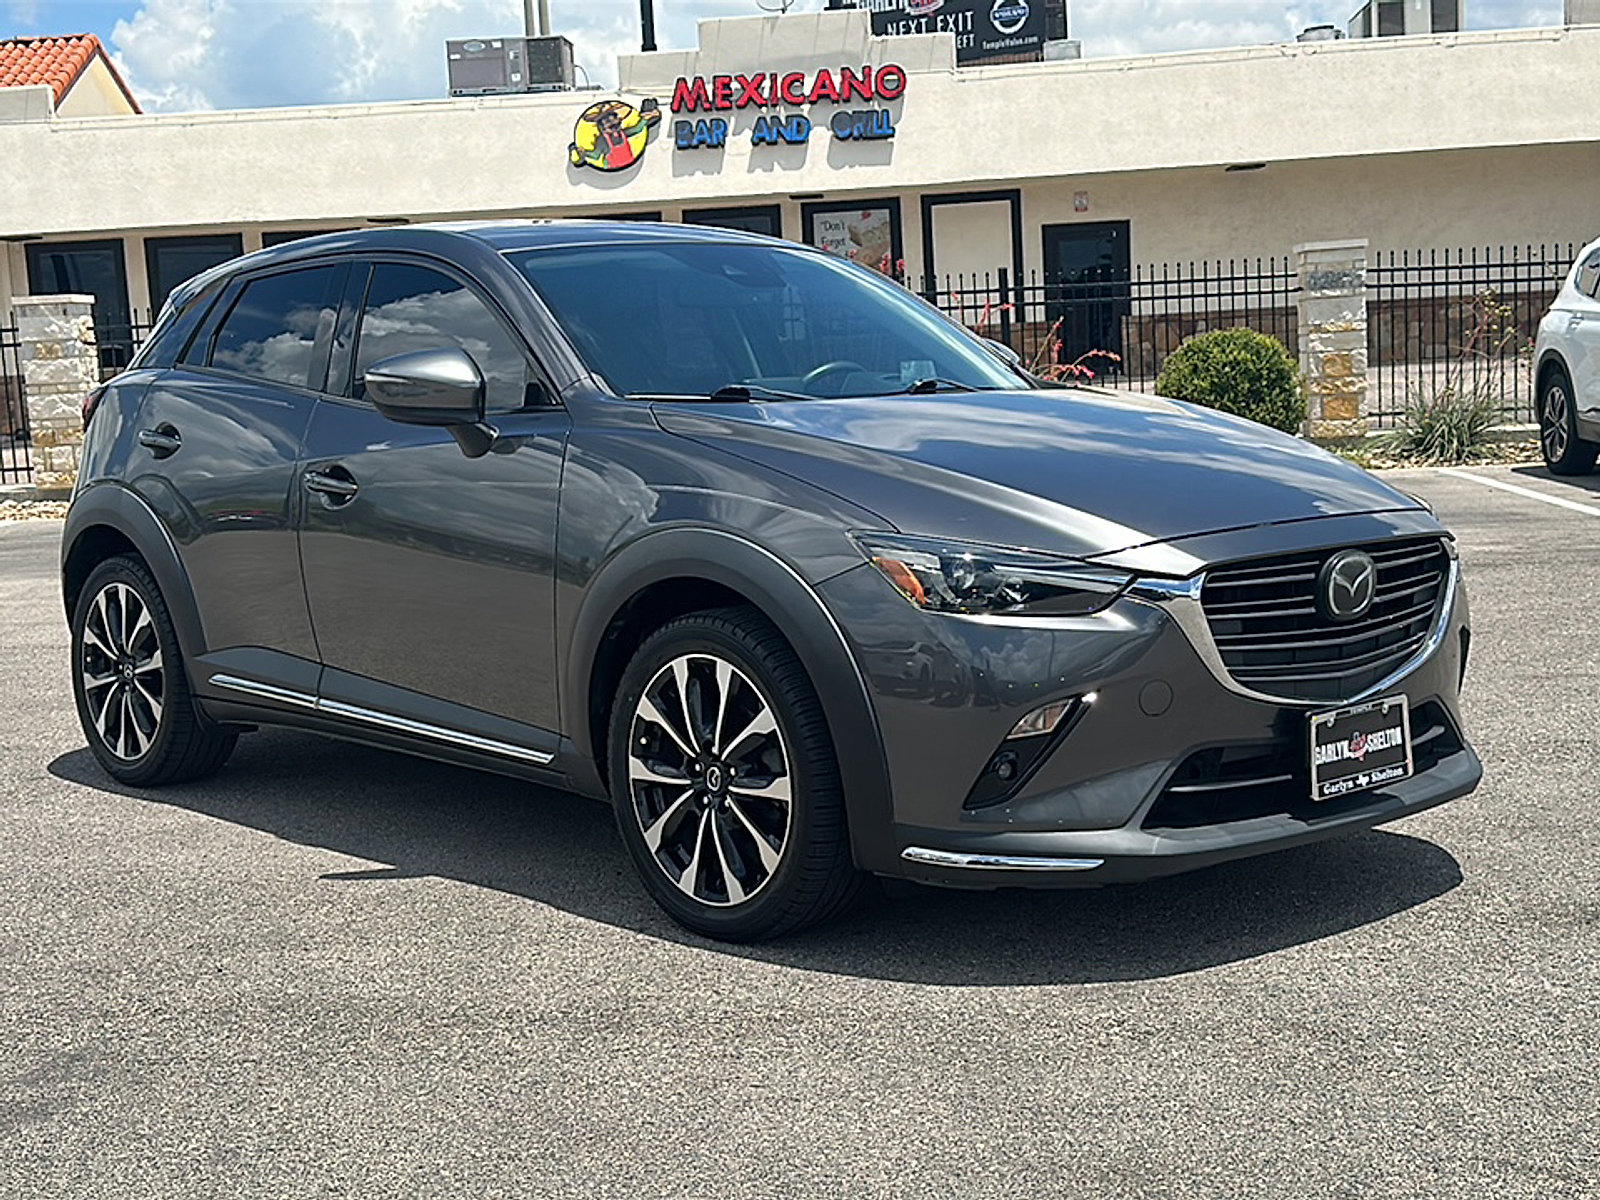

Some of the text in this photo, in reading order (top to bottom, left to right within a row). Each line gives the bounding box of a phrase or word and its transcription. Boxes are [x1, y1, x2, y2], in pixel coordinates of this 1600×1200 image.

[886, 11, 975, 36] NEXT EXIT
[993, 8, 1026, 18] VOLVO
[956, 33, 975, 49] EFT
[671, 64, 907, 112] MEXICANO
[675, 109, 896, 149] BAR AND GRILL
[1315, 727, 1403, 765] GARLYN SHELTON
[1323, 767, 1404, 794] Garlyn Shelton
